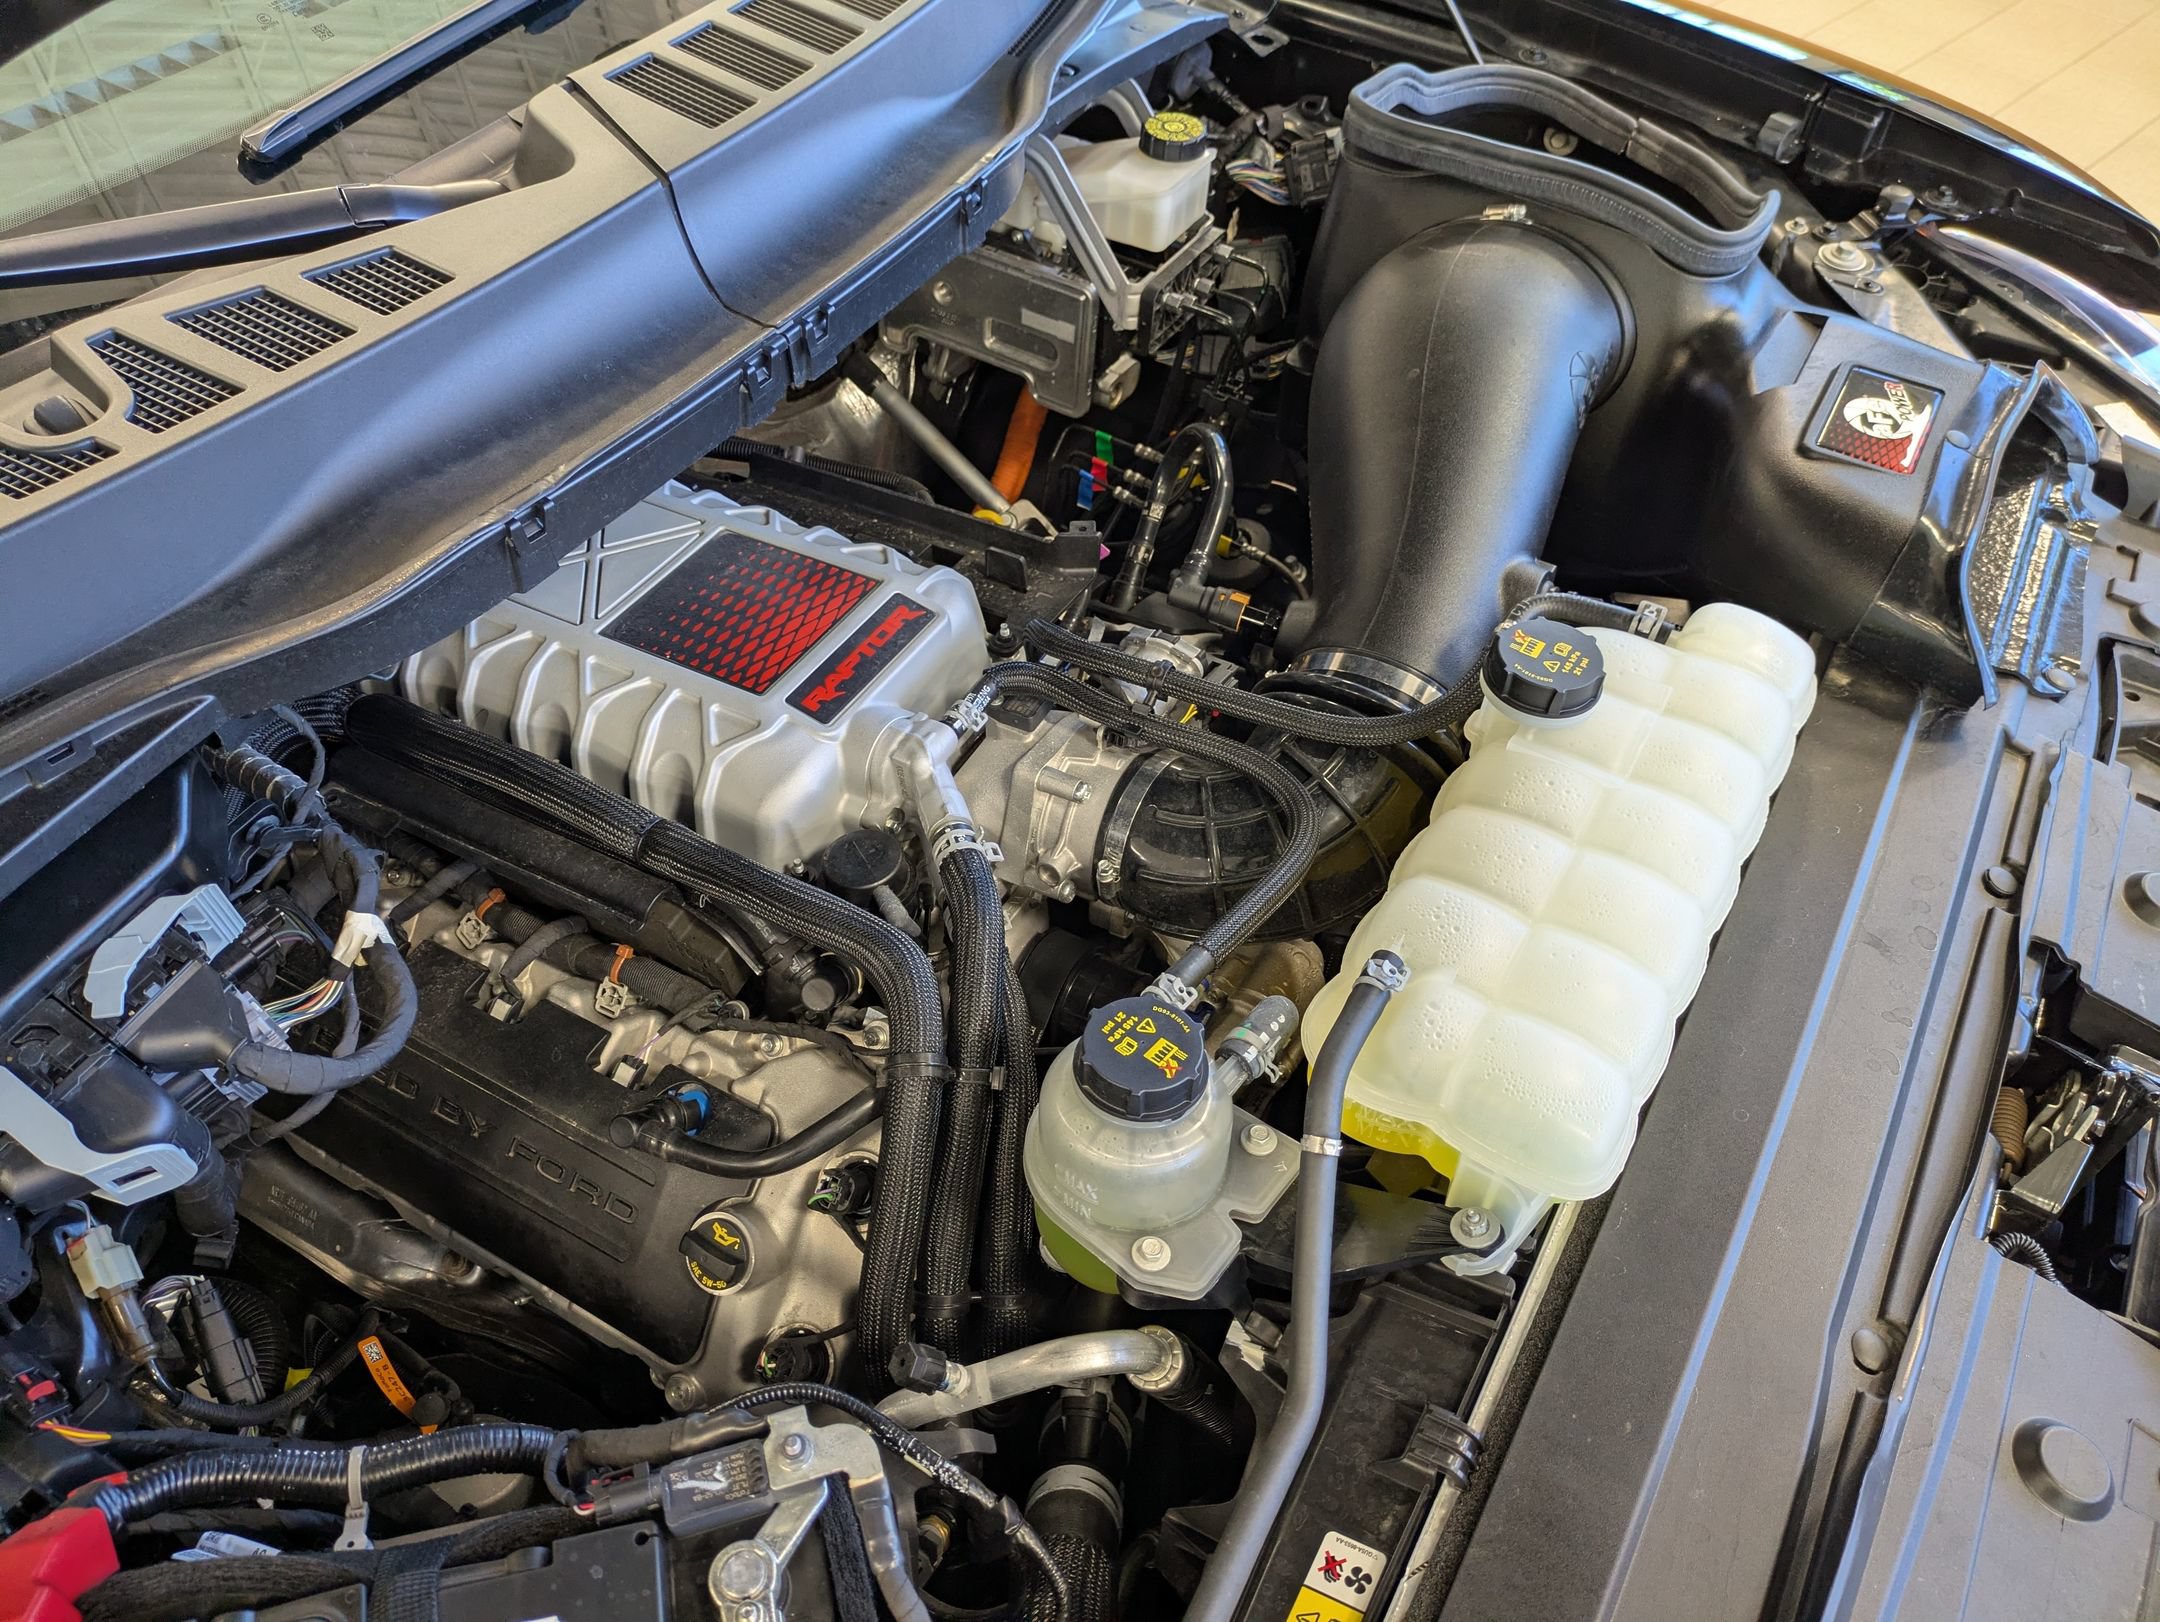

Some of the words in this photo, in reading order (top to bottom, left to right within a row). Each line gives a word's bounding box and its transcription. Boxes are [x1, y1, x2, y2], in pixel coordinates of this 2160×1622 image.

[1884, 381, 1915, 421] POWER
[801, 604, 927, 712] RAPTOR
[1114, 1011, 1127, 1023] 21
[1122, 1015, 1139, 1031] 145
[1101, 1020, 1115, 1034] psi
[1107, 1028, 1125, 1043] kPa
[506, 1134, 640, 1225] FORD
[690, 1261, 703, 1278] SAE
